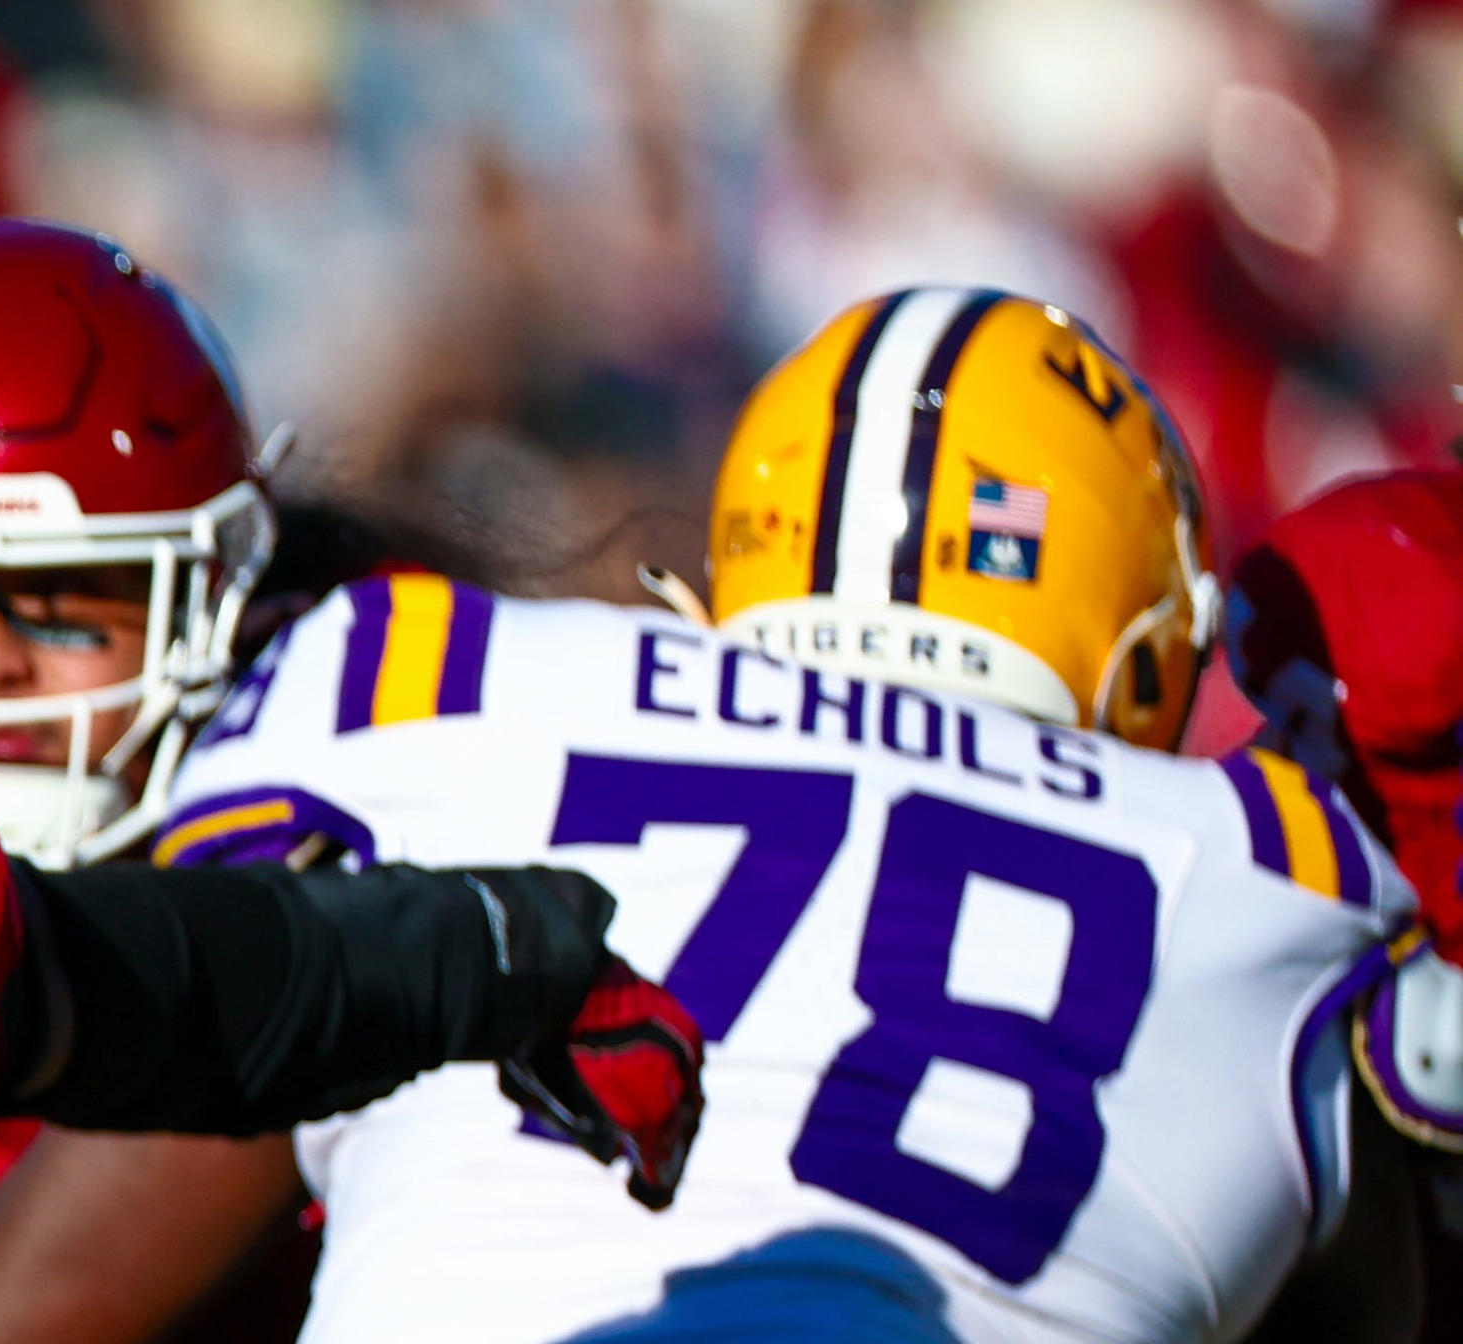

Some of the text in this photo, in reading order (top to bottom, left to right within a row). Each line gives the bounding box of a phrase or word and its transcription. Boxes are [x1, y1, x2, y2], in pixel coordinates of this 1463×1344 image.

[635, 629, 1103, 802] ECHOLS
[755, 622, 991, 676] TIGERS
[518, 750, 1159, 1287] 78
